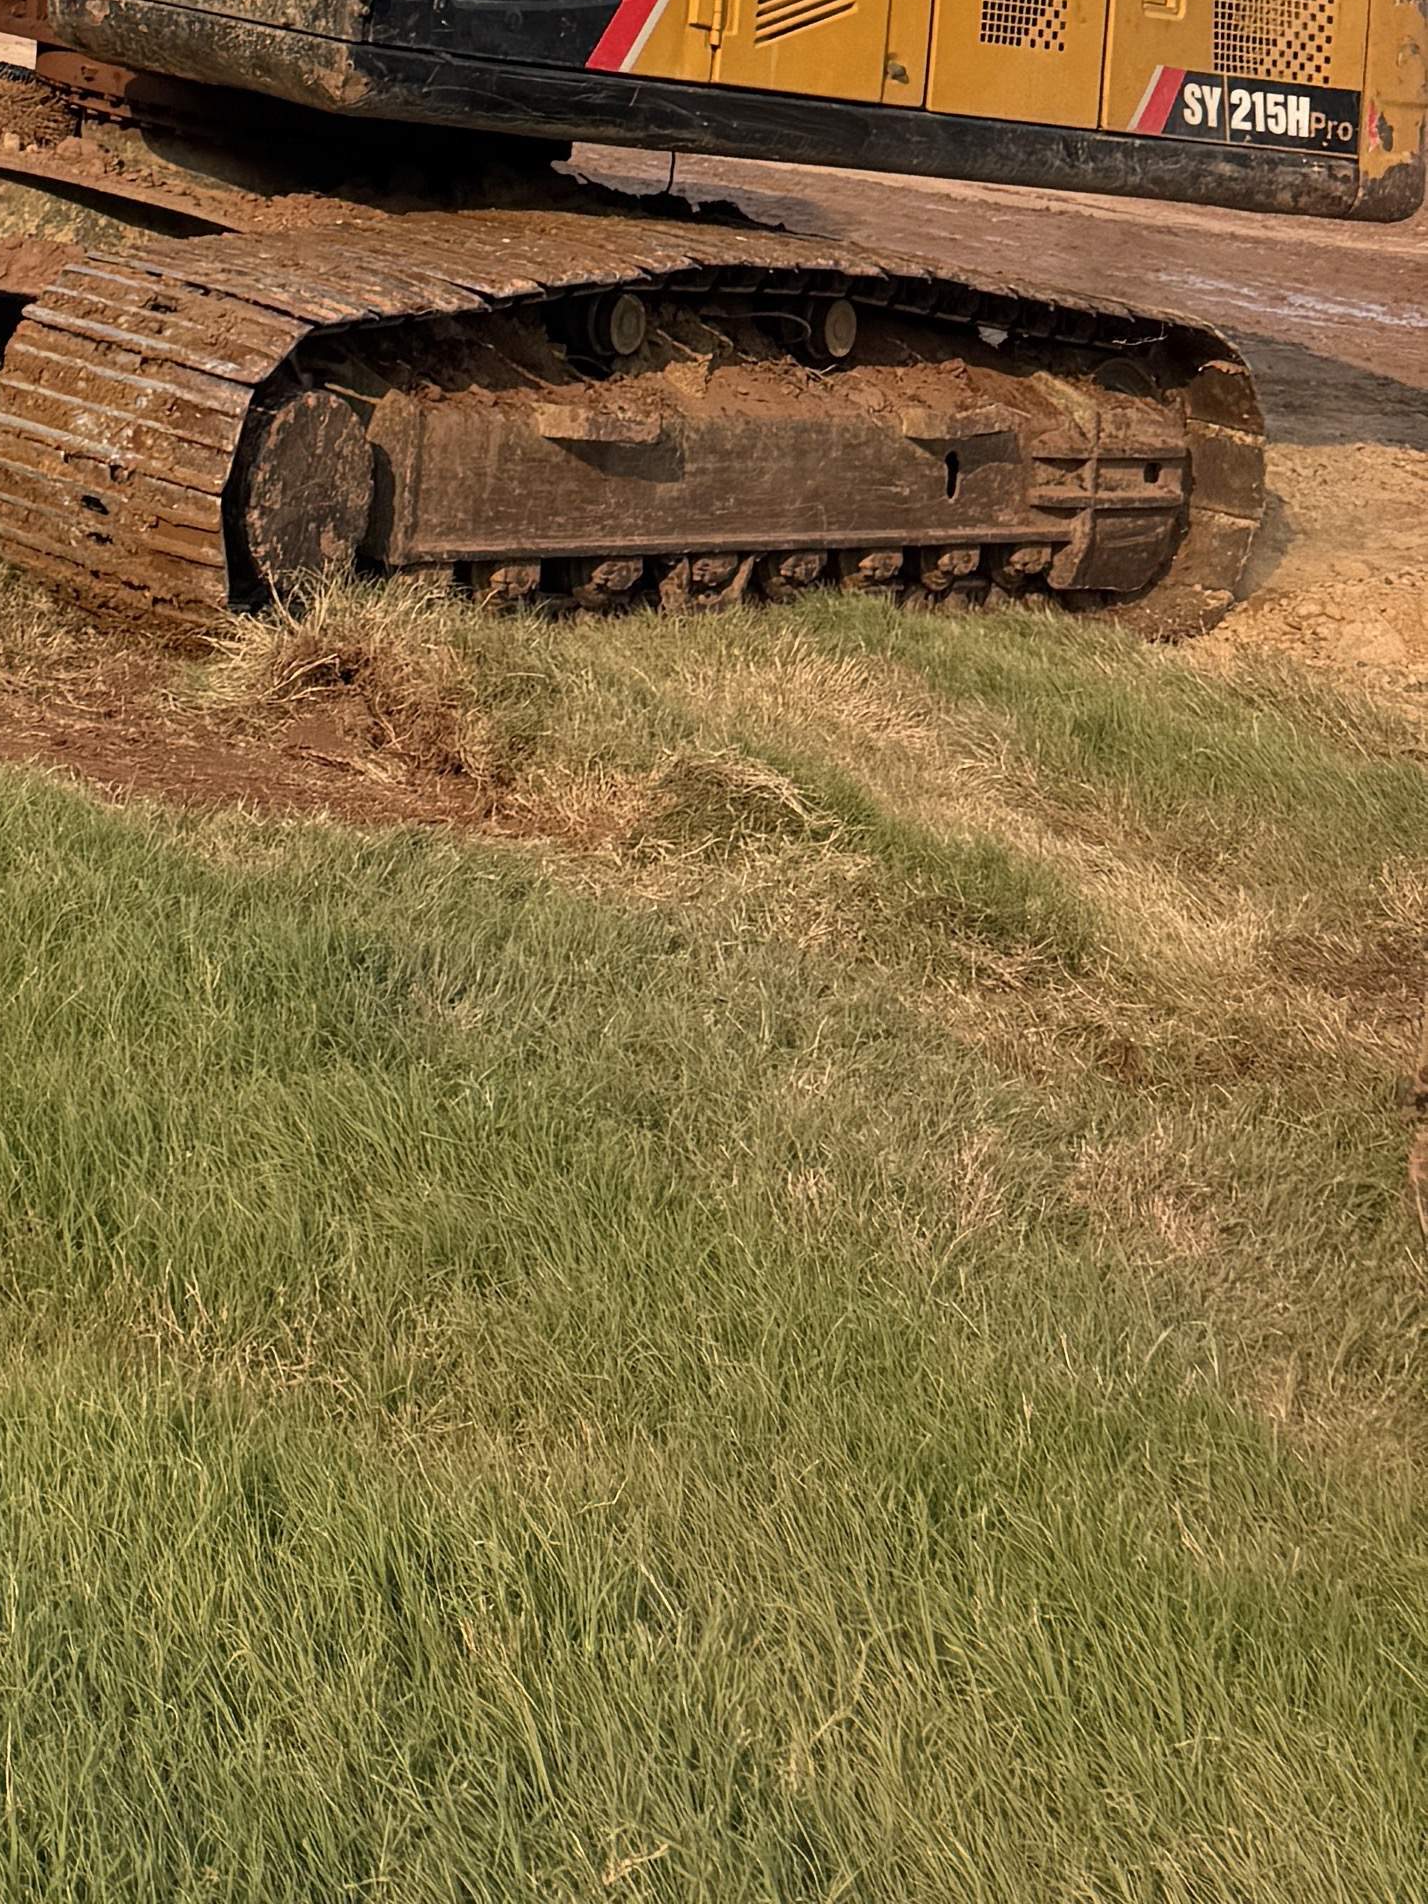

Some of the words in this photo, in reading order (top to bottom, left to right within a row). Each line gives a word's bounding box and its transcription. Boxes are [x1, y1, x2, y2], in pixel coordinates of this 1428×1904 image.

[1183, 83, 1222, 127] SY
[1230, 89, 1311, 138] 215H
[1311, 113, 1353, 142] Pro
